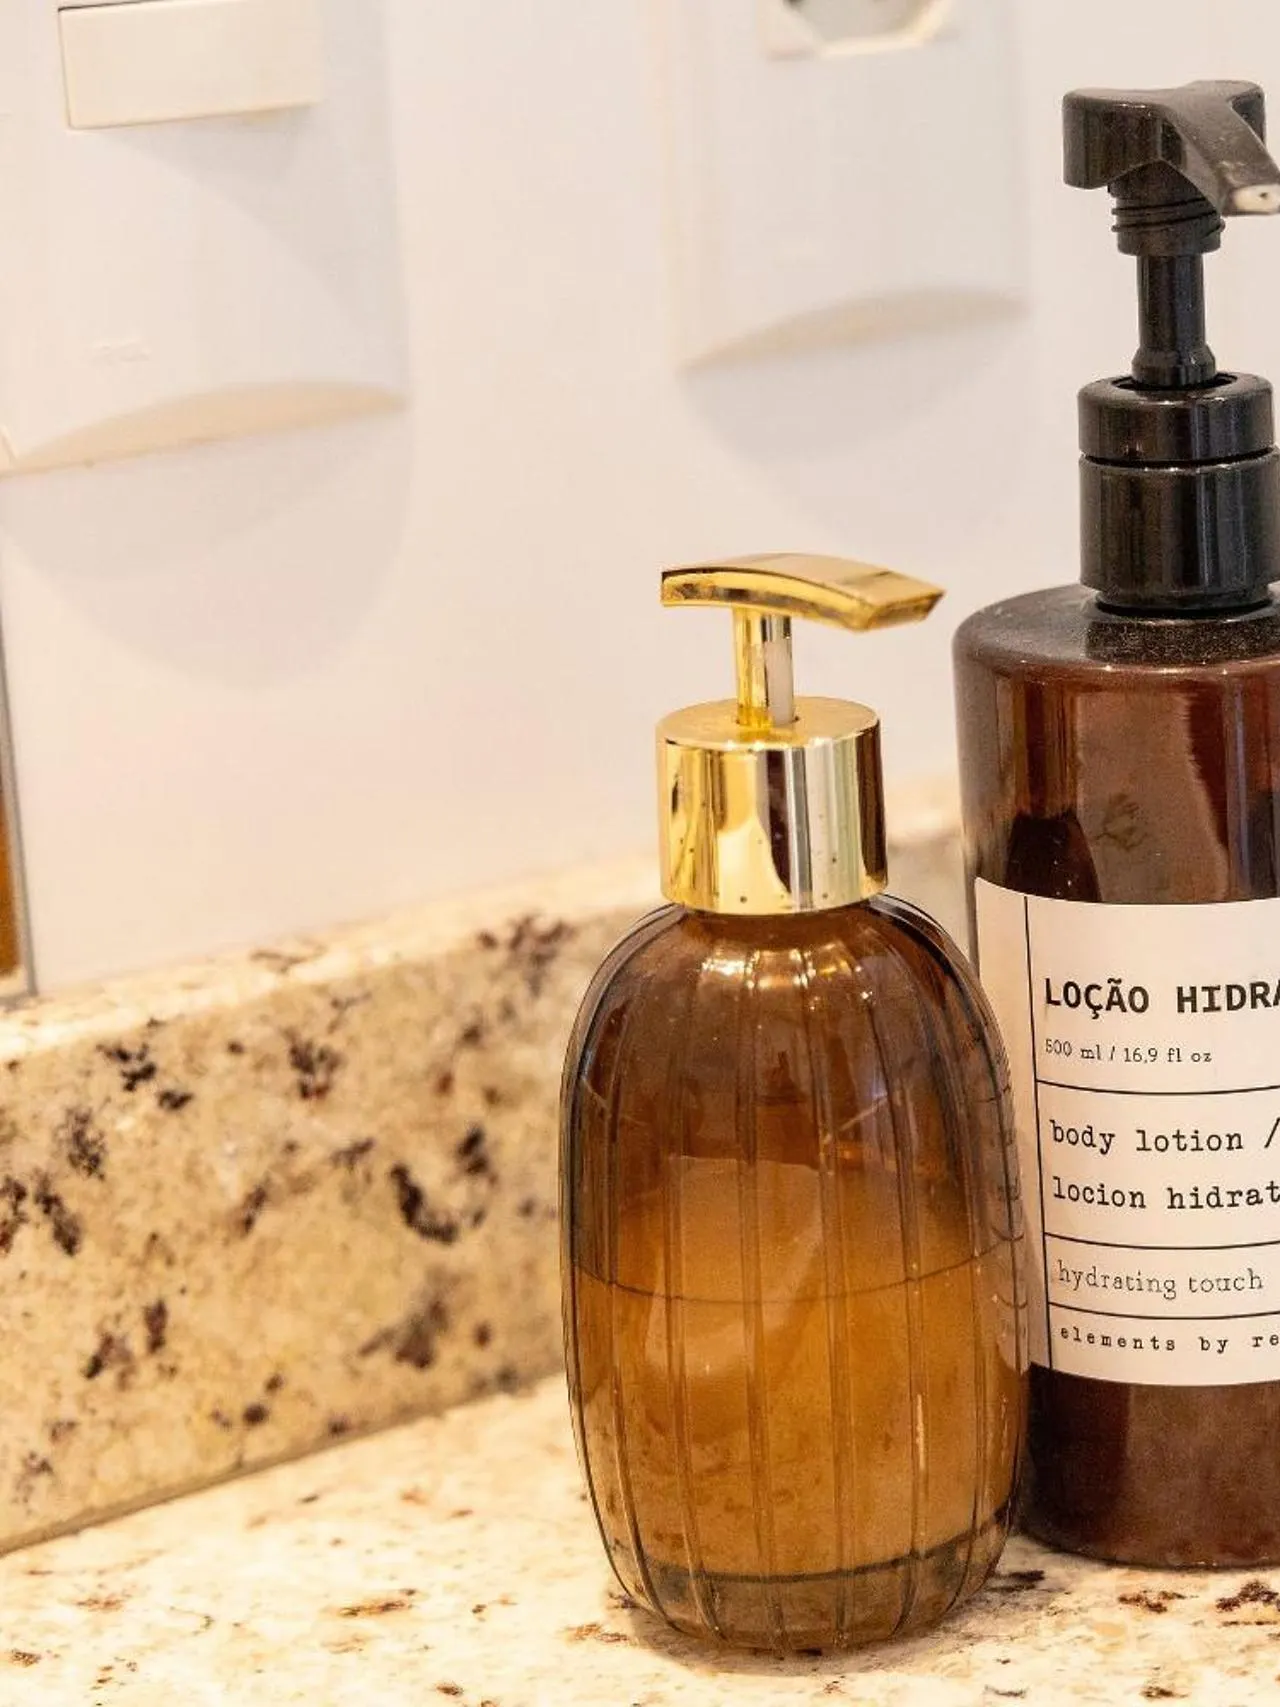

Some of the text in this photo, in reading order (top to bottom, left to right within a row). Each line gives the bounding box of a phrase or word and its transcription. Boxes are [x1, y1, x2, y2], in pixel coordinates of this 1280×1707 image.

[1045, 977, 1149, 1019] LOÇÃO
[1045, 1038, 1073, 1057] 500
[1080, 1043, 1101, 1060] ml
[1167, 1048, 1182, 1063] fl
[1190, 1053, 1212, 1063] oz
[1049, 1119, 1115, 1155] body
[1136, 1129, 1244, 1153] lotion
[1052, 1176, 1147, 1208] locion
[1057, 1260, 1264, 1300] hydrating touch
[1060, 1327, 1176, 1352] elements
[1200, 1336, 1229, 1355] by
